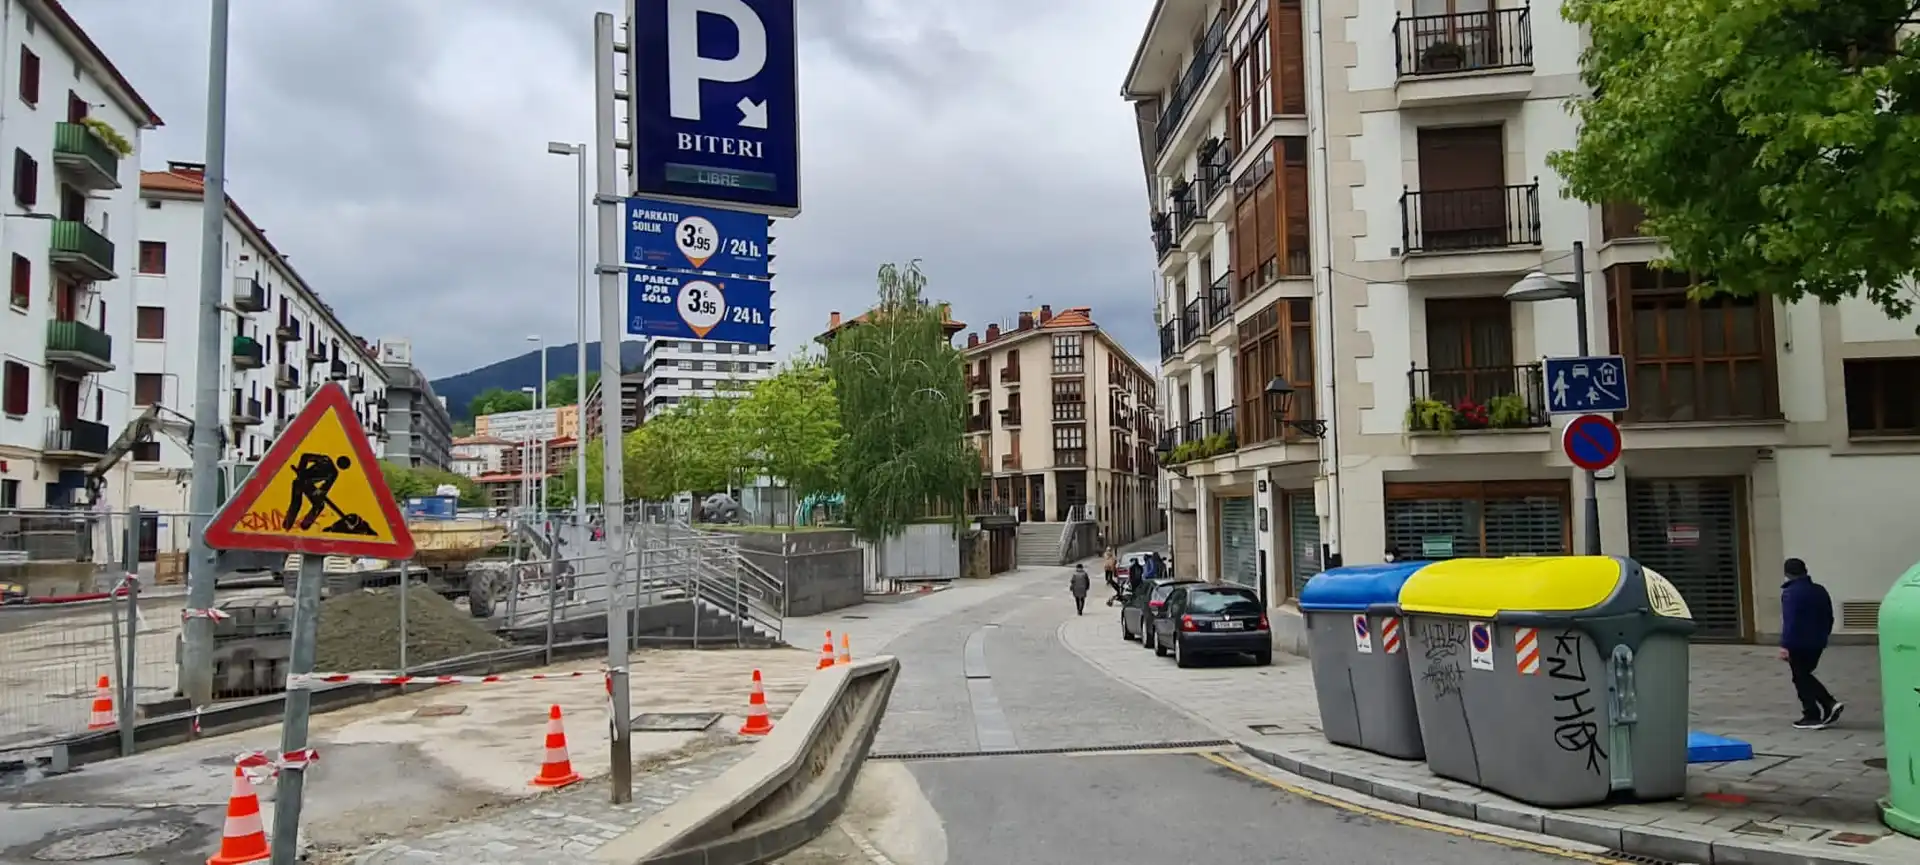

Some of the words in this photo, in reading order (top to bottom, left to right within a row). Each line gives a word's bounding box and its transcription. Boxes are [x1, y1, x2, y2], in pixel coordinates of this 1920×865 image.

[667, 0, 767, 120] P
[677, 132, 764, 159] BITERI
[698, 171, 741, 187] LIBRE
[632, 209, 678, 222] APARKATU
[632, 221, 661, 232] SOILIK
[730, 239, 748, 256] 24
[634, 274, 679, 286] APARCA
[645, 285, 668, 294] POR
[733, 306, 750, 323] 24
